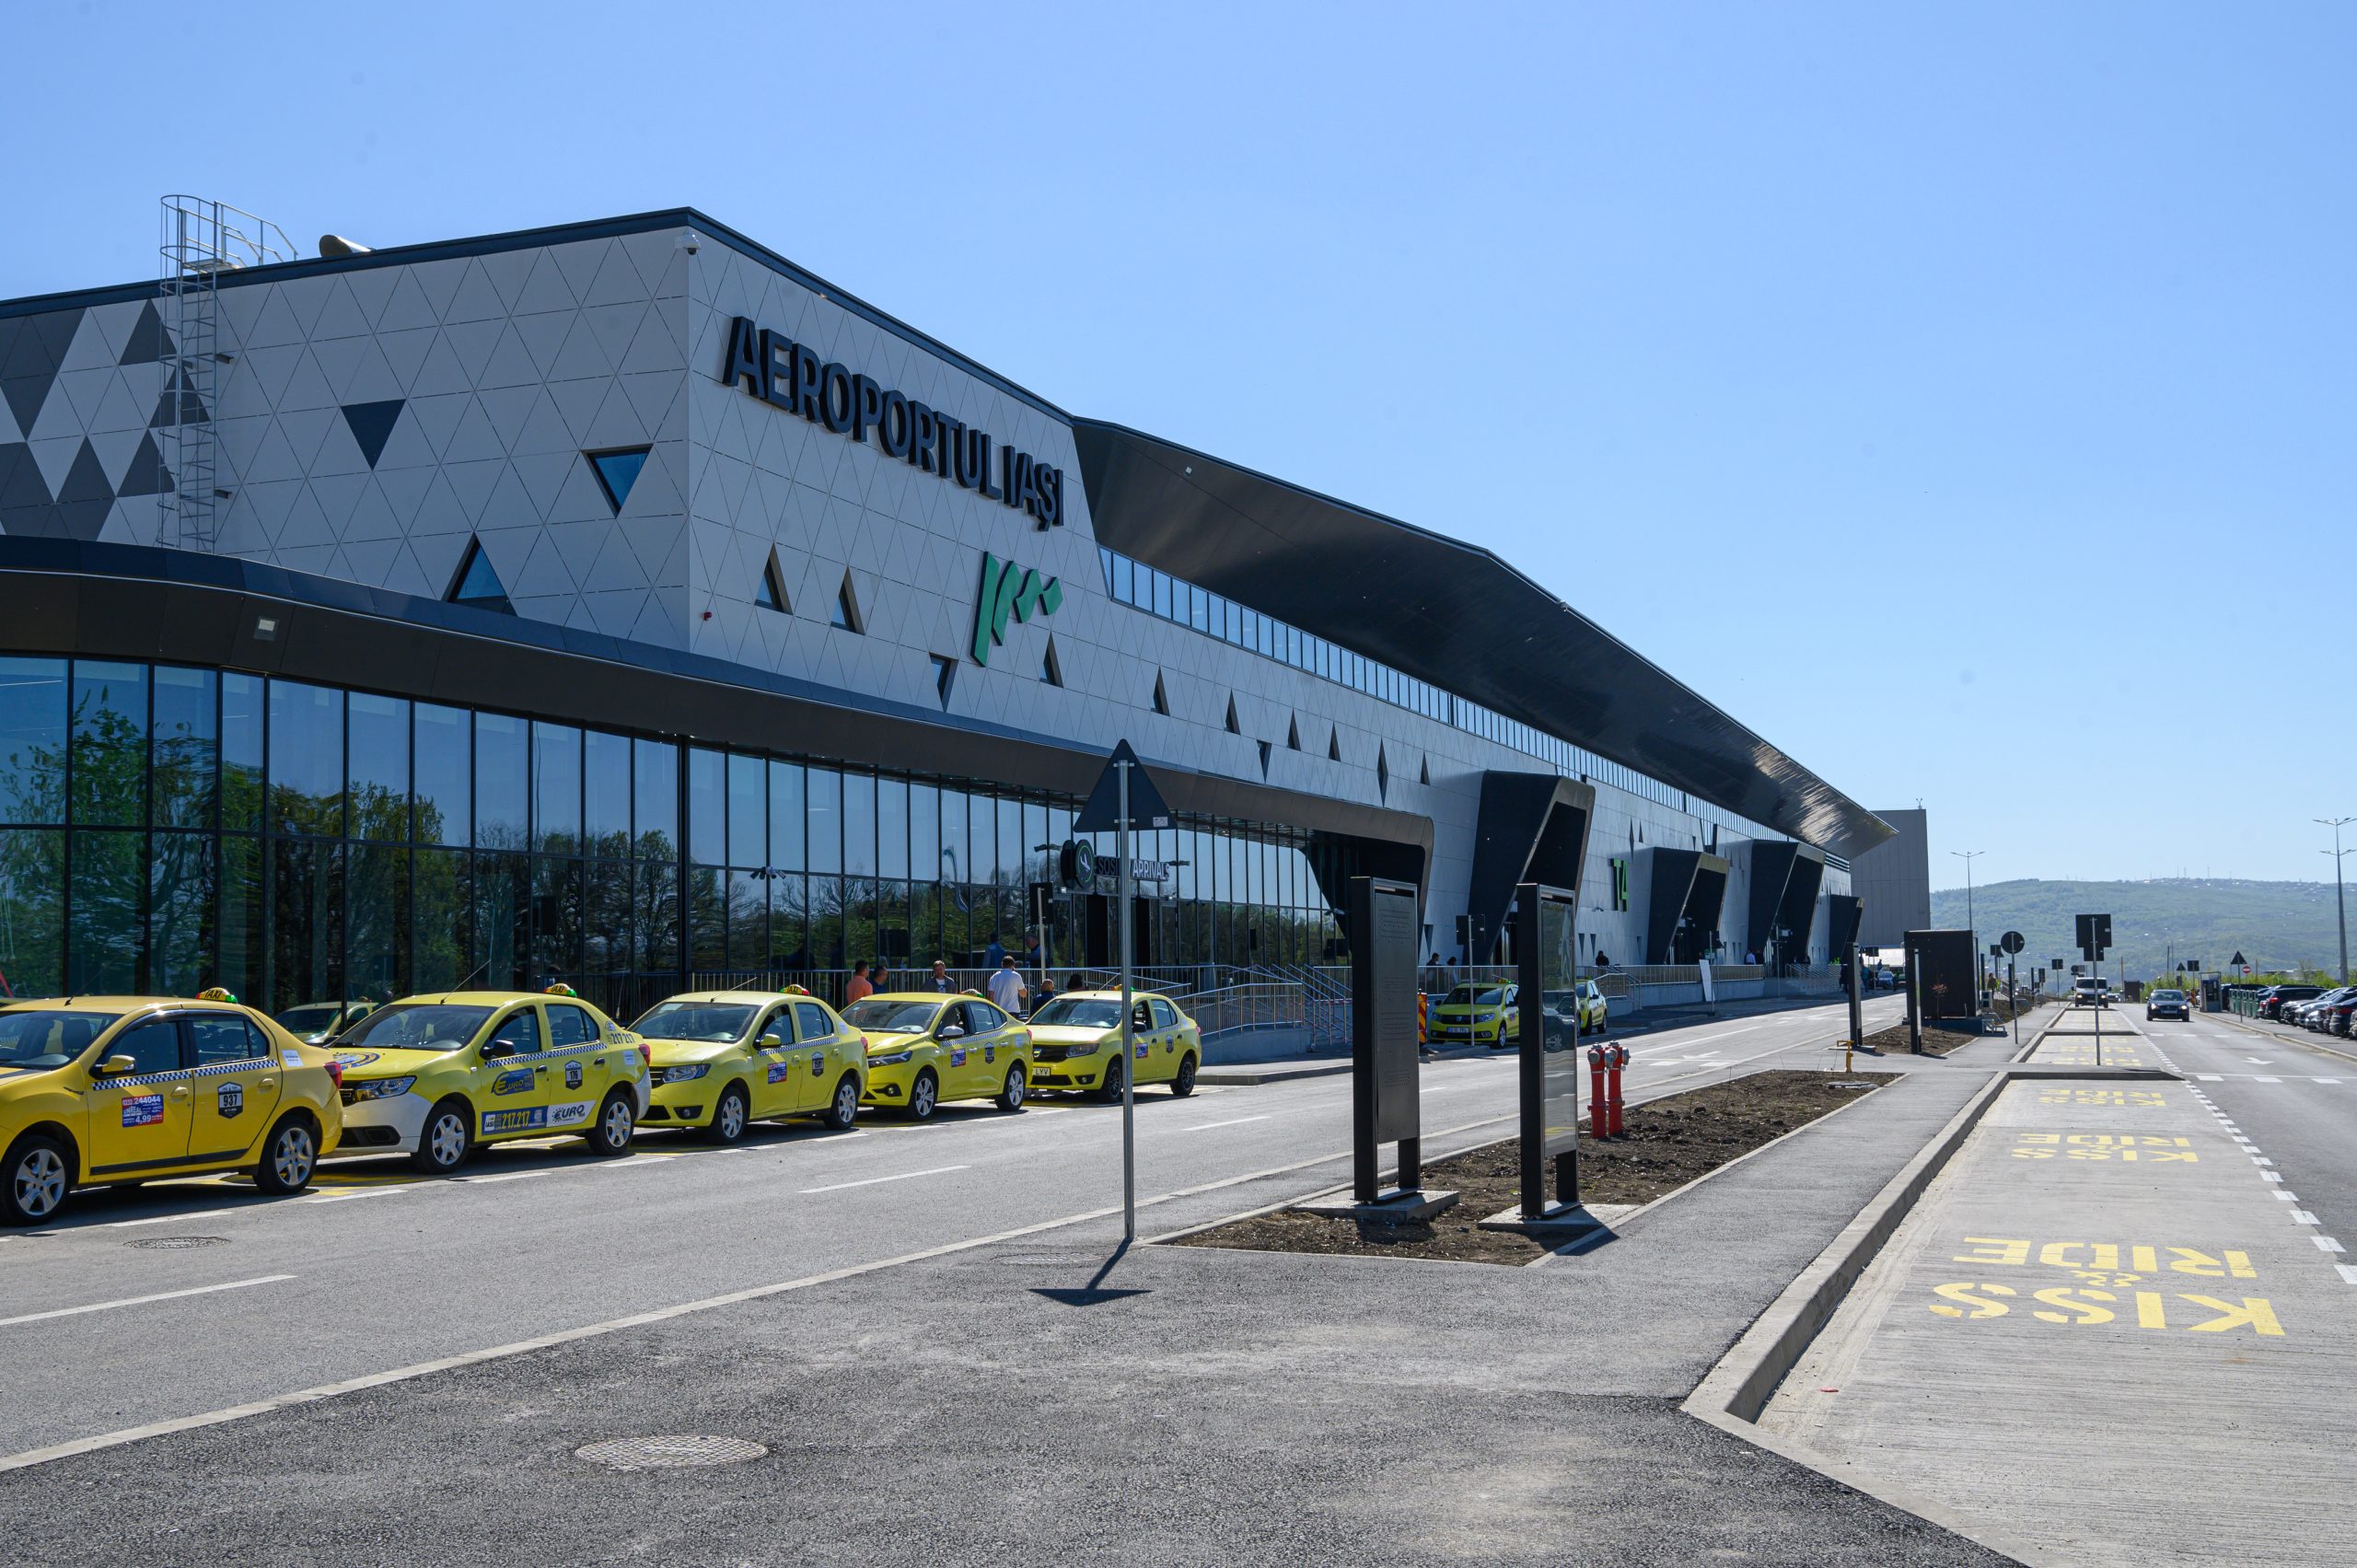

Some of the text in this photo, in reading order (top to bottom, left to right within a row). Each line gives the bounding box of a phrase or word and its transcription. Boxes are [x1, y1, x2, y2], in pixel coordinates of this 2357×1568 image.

[722, 316, 1003, 501] AEROPORTUL
[1132, 860, 1170, 881] ARRIVALS
[204, 989, 223, 999] TAXI
[551, 985, 564, 993] TAXI
[134, 1095, 161, 1105] 244044
[223, 1093, 238, 1108] 937
[2017, 1132, 2191, 1147] RIDE
[2011, 1147, 2200, 1163] KISS
[1953, 1237, 2258, 1279] RIDE
[2069, 1269, 2142, 1288] &
[1928, 1281, 2285, 1337] KISS
